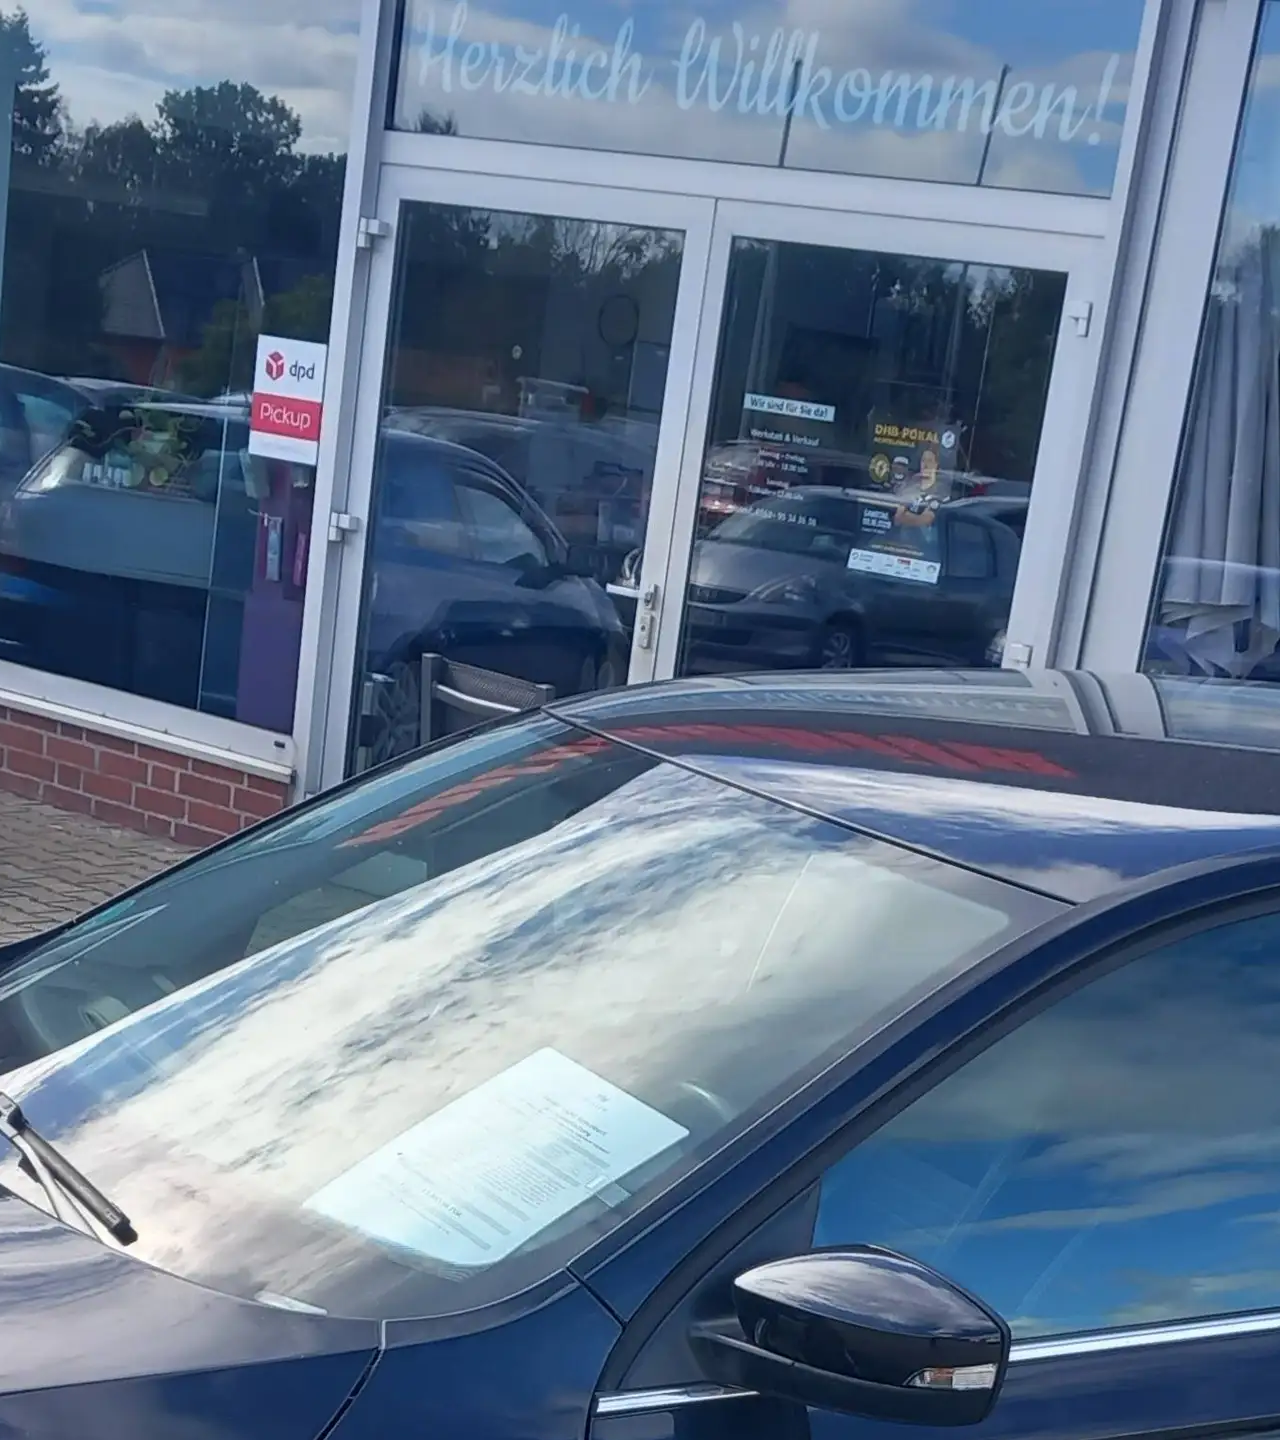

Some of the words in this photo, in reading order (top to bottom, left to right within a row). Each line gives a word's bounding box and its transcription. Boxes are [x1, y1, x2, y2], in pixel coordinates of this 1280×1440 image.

[411, 2, 656, 104] Herzlich
[671, 17, 1120, 146] Willkommen!
[289, 360, 316, 382] dpd
[260, 403, 311, 432] Pickup
[750, 395, 766, 408] Wir
[767, 400, 784, 411] sind
[785, 402, 798, 413] für
[799, 404, 812, 416] Sie
[813, 406, 828, 419] da!
[792, 434, 820, 447] Verkauf
